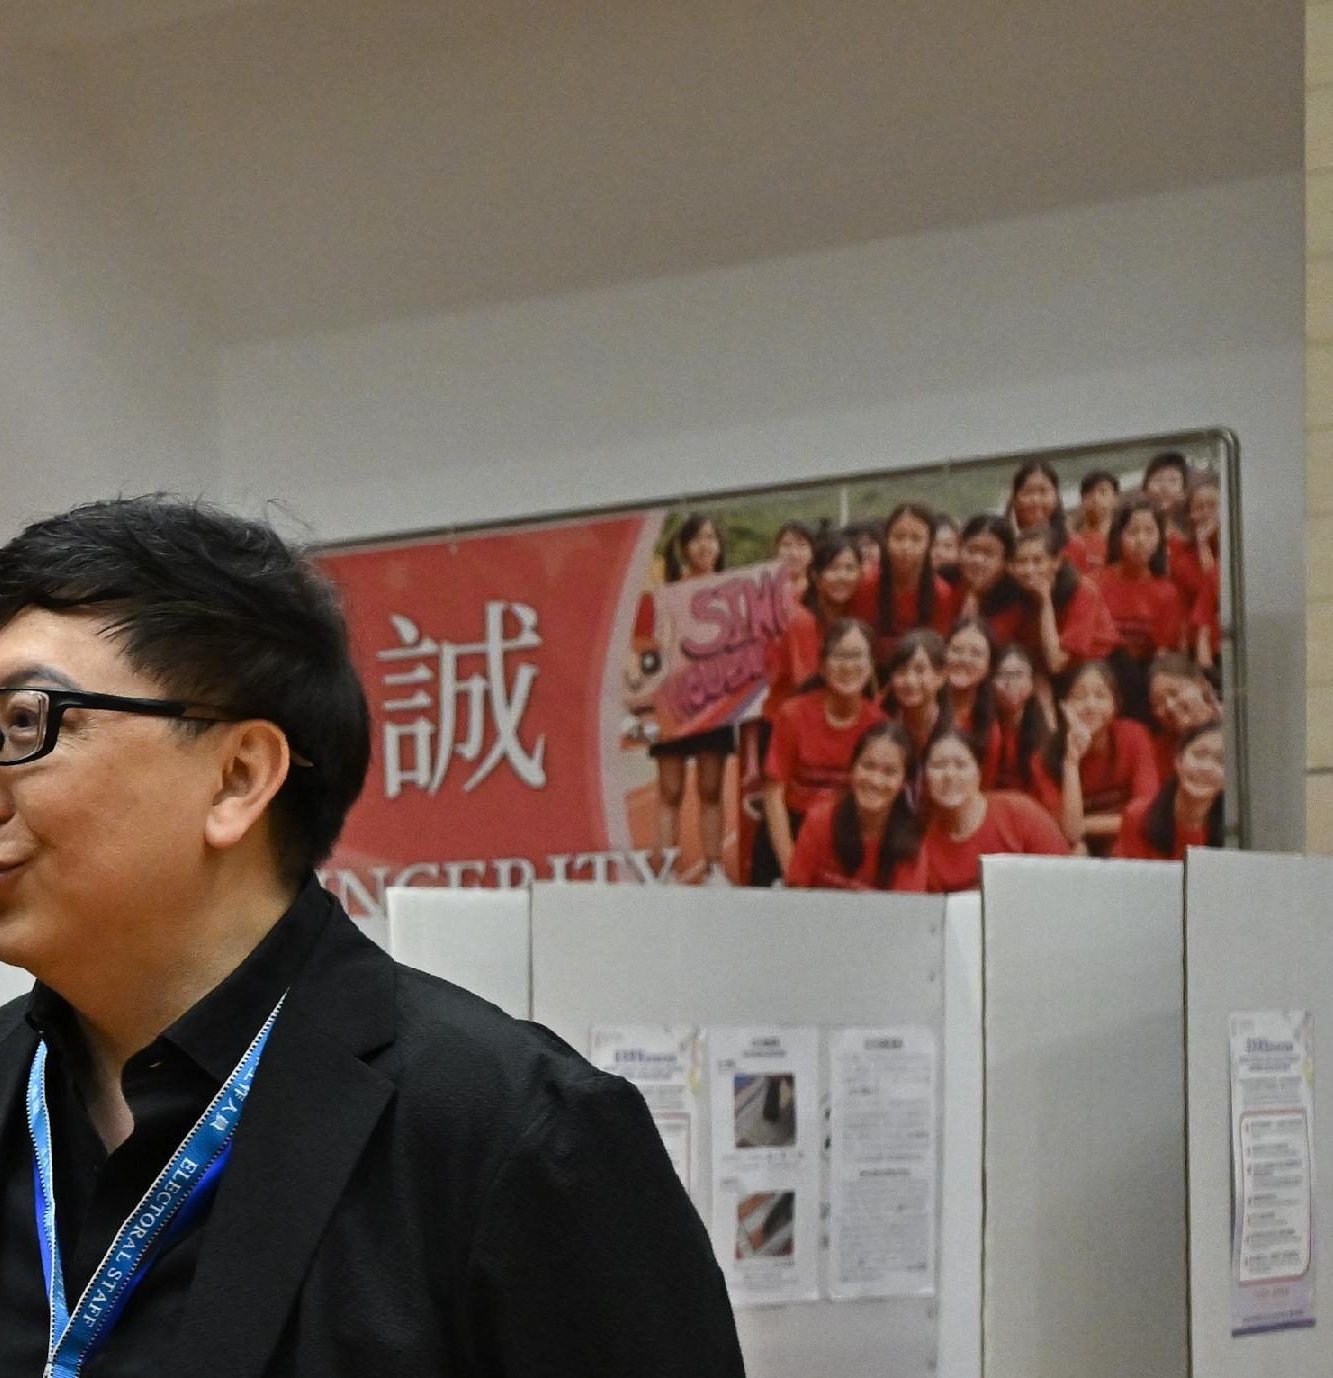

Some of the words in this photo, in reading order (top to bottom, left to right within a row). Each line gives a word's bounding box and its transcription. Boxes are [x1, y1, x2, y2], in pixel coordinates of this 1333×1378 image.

[377, 601, 546, 797] 誠
[314, 848, 680, 919] NCERITY
[115, 1156, 198, 1262] ELECTORAL
[82, 1266, 123, 1328] STAFF
